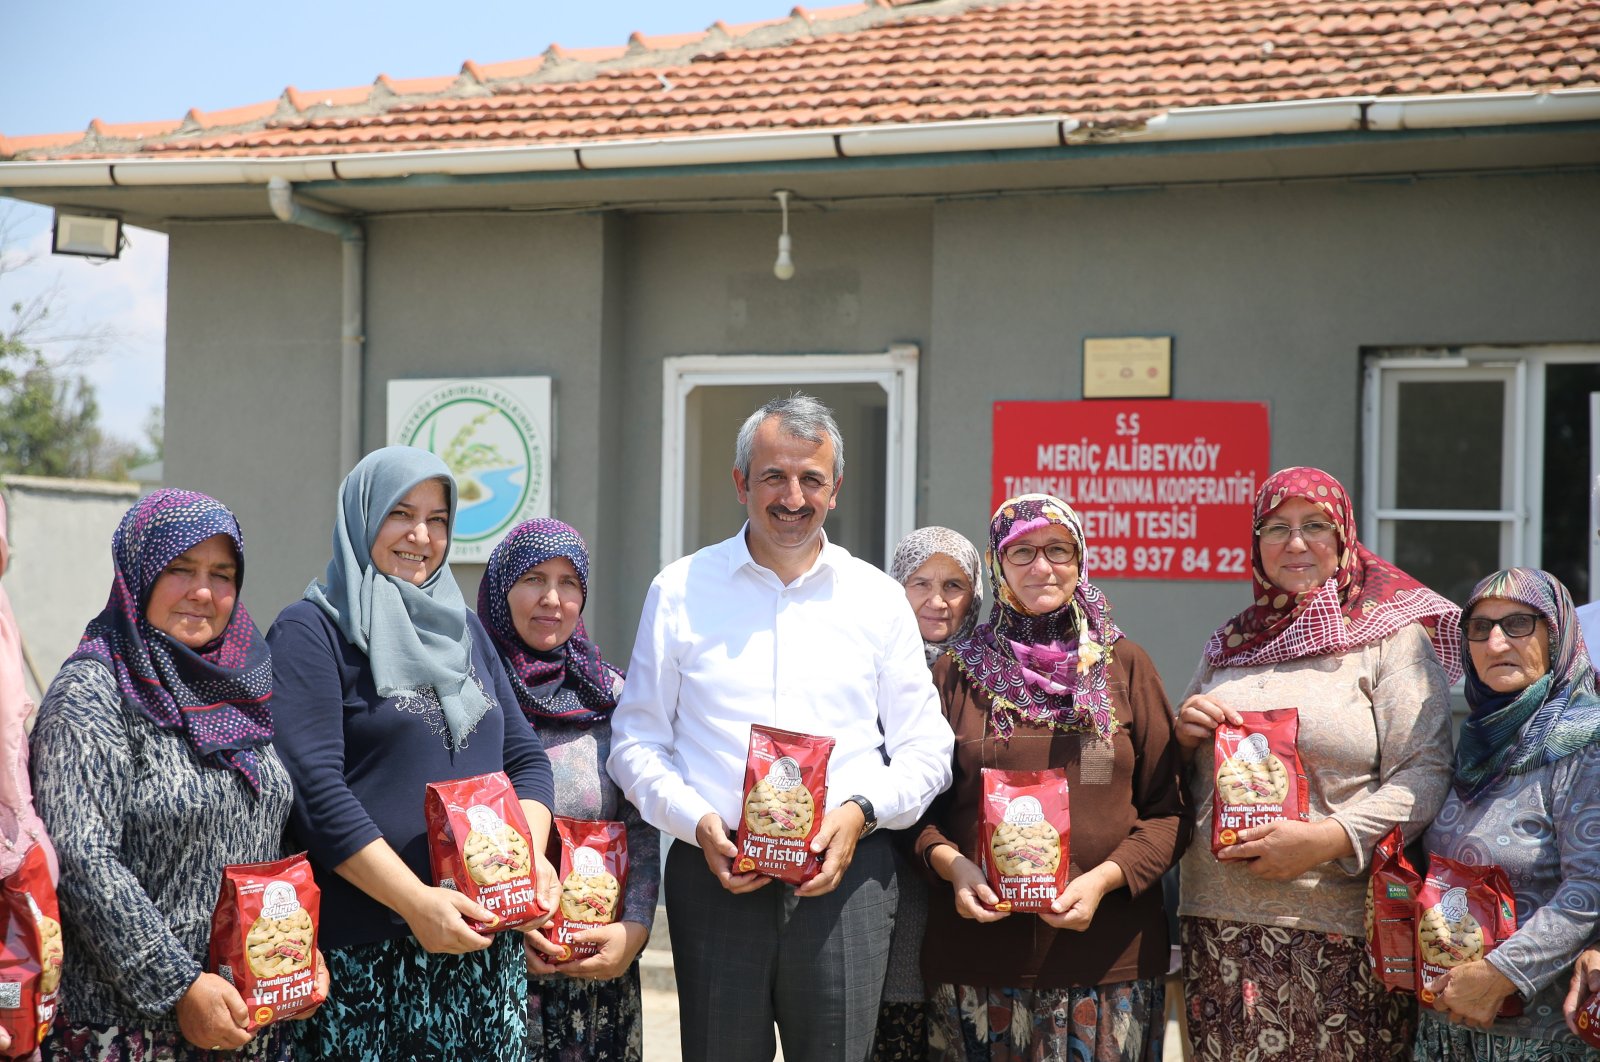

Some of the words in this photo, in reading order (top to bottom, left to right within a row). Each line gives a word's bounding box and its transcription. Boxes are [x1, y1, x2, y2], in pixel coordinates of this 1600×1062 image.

[1116, 413, 1140, 436] S.S
[1037, 439, 1101, 475] MERİÇ
[1104, 438, 1221, 472] ALİBEYKÖY
[1004, 476, 1074, 503] TARIMSAL
[1077, 476, 1154, 504] KALKINMA
[1157, 471, 1256, 505] KOOPERATİFİ
[1077, 504, 1131, 539] ETİM
[1134, 505, 1197, 539] TESİSİ
[1133, 546, 1176, 572] 937
[1182, 546, 1210, 572] 84
[1216, 547, 1246, 573] 22
[1256, 804, 1282, 812] Kabuklu
[1221, 812, 1241, 828] Yer
[748, 833, 779, 845] Kavrulmuş
[780, 838, 805, 847] Kabuklu
[743, 840, 763, 858] Yer
[766, 844, 808, 867] Fıstığı
[1000, 876, 1031, 884] Kavrulmuş
[1031, 875, 1056, 883] Kabuklu
[479, 883, 512, 894] Kavrulmuş
[999, 883, 1018, 899] Yer
[262, 902, 298, 917] edirne
[476, 895, 501, 910] Yer
[558, 927, 573, 944] Ye
[257, 976, 293, 988] Kavrulmuş
[253, 988, 279, 1006] Yer
